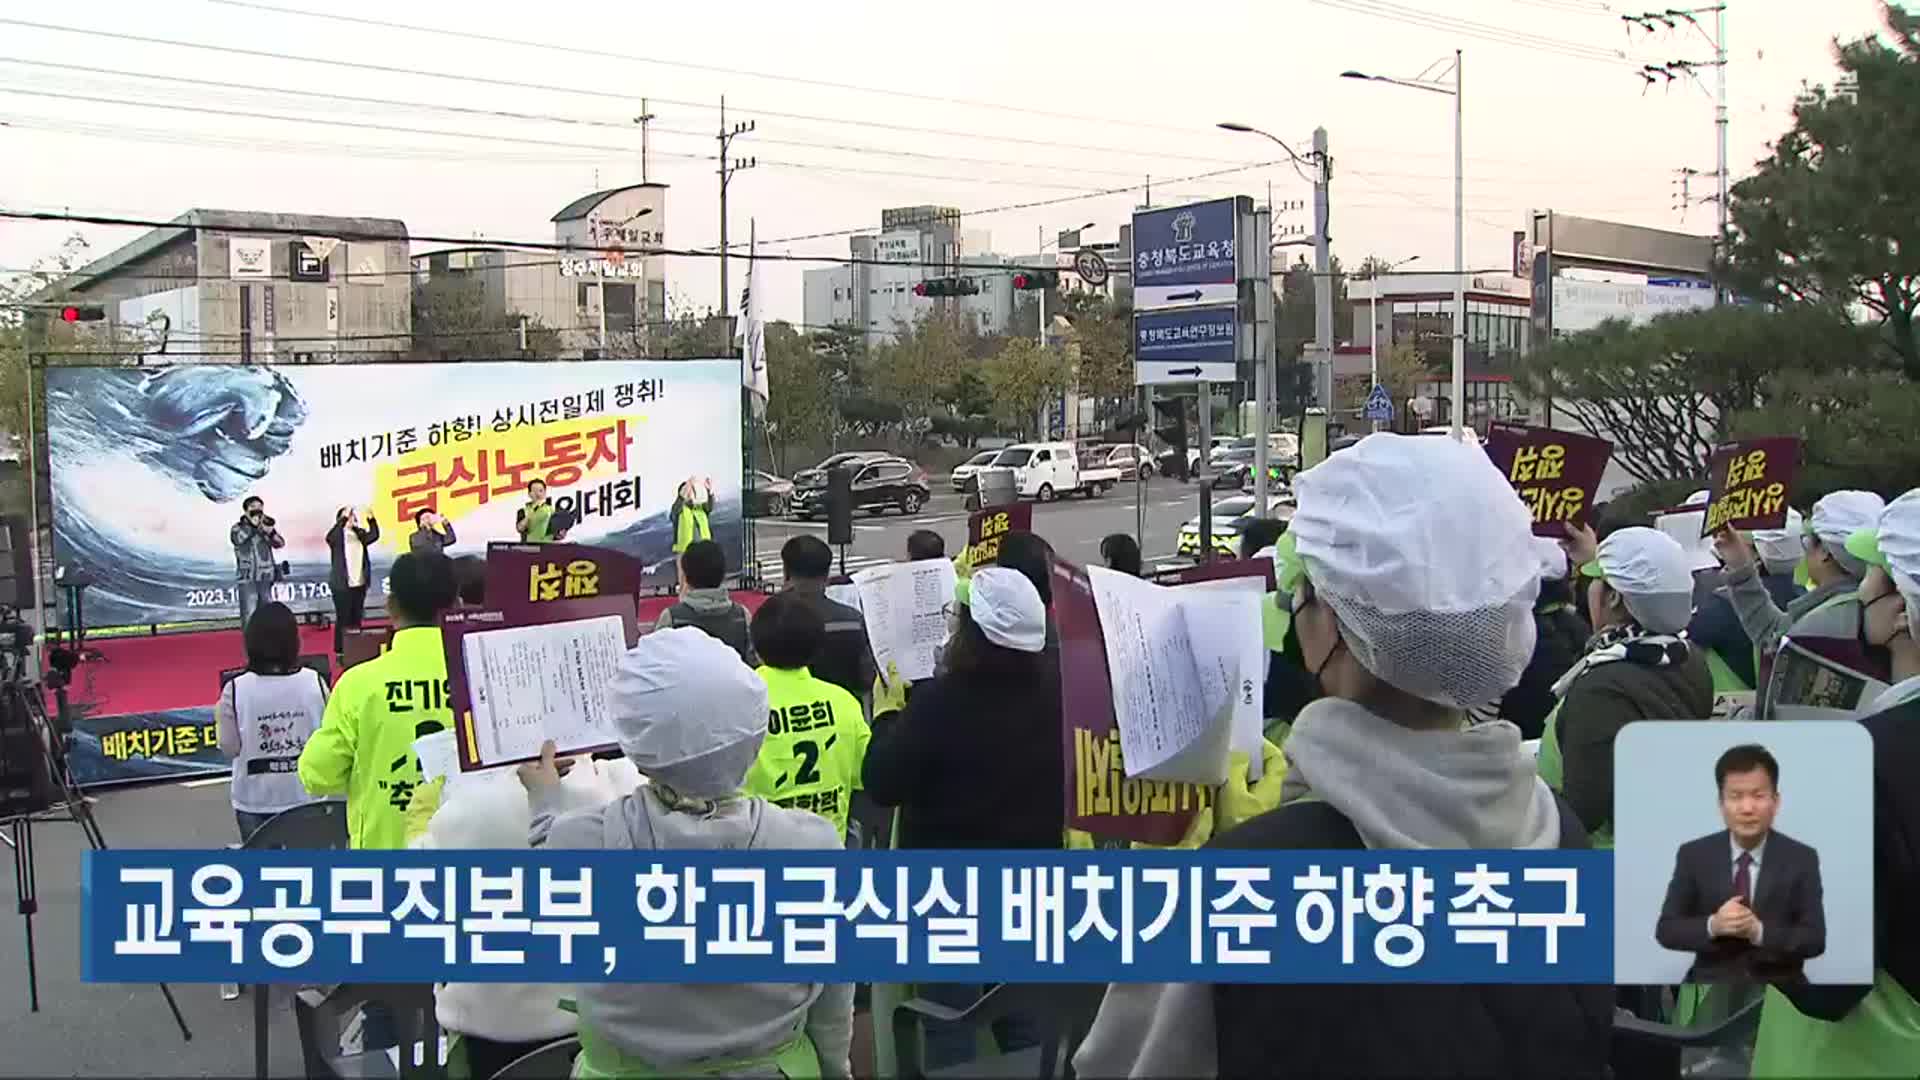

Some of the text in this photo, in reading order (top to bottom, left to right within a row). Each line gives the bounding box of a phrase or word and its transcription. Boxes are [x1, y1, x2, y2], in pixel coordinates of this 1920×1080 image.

[1137, 239, 1234, 270] 충청북도교육청
[320, 378, 665, 469] 배치기준 하향! 상시전일제 쟁취!
[392, 419, 633, 524] 급식노동자
[1510, 444, 1566, 482] 쟁취
[1726, 449, 1767, 490] 쟁취
[547, 476, 642, 527] 의대회
[186, 588, 240, 607] 2023.1
[529, 559, 600, 602] 쟁취
[768, 700, 835, 735] 이윤희
[103, 725, 199, 761] 배치기준
[793, 740, 820, 785] 2
